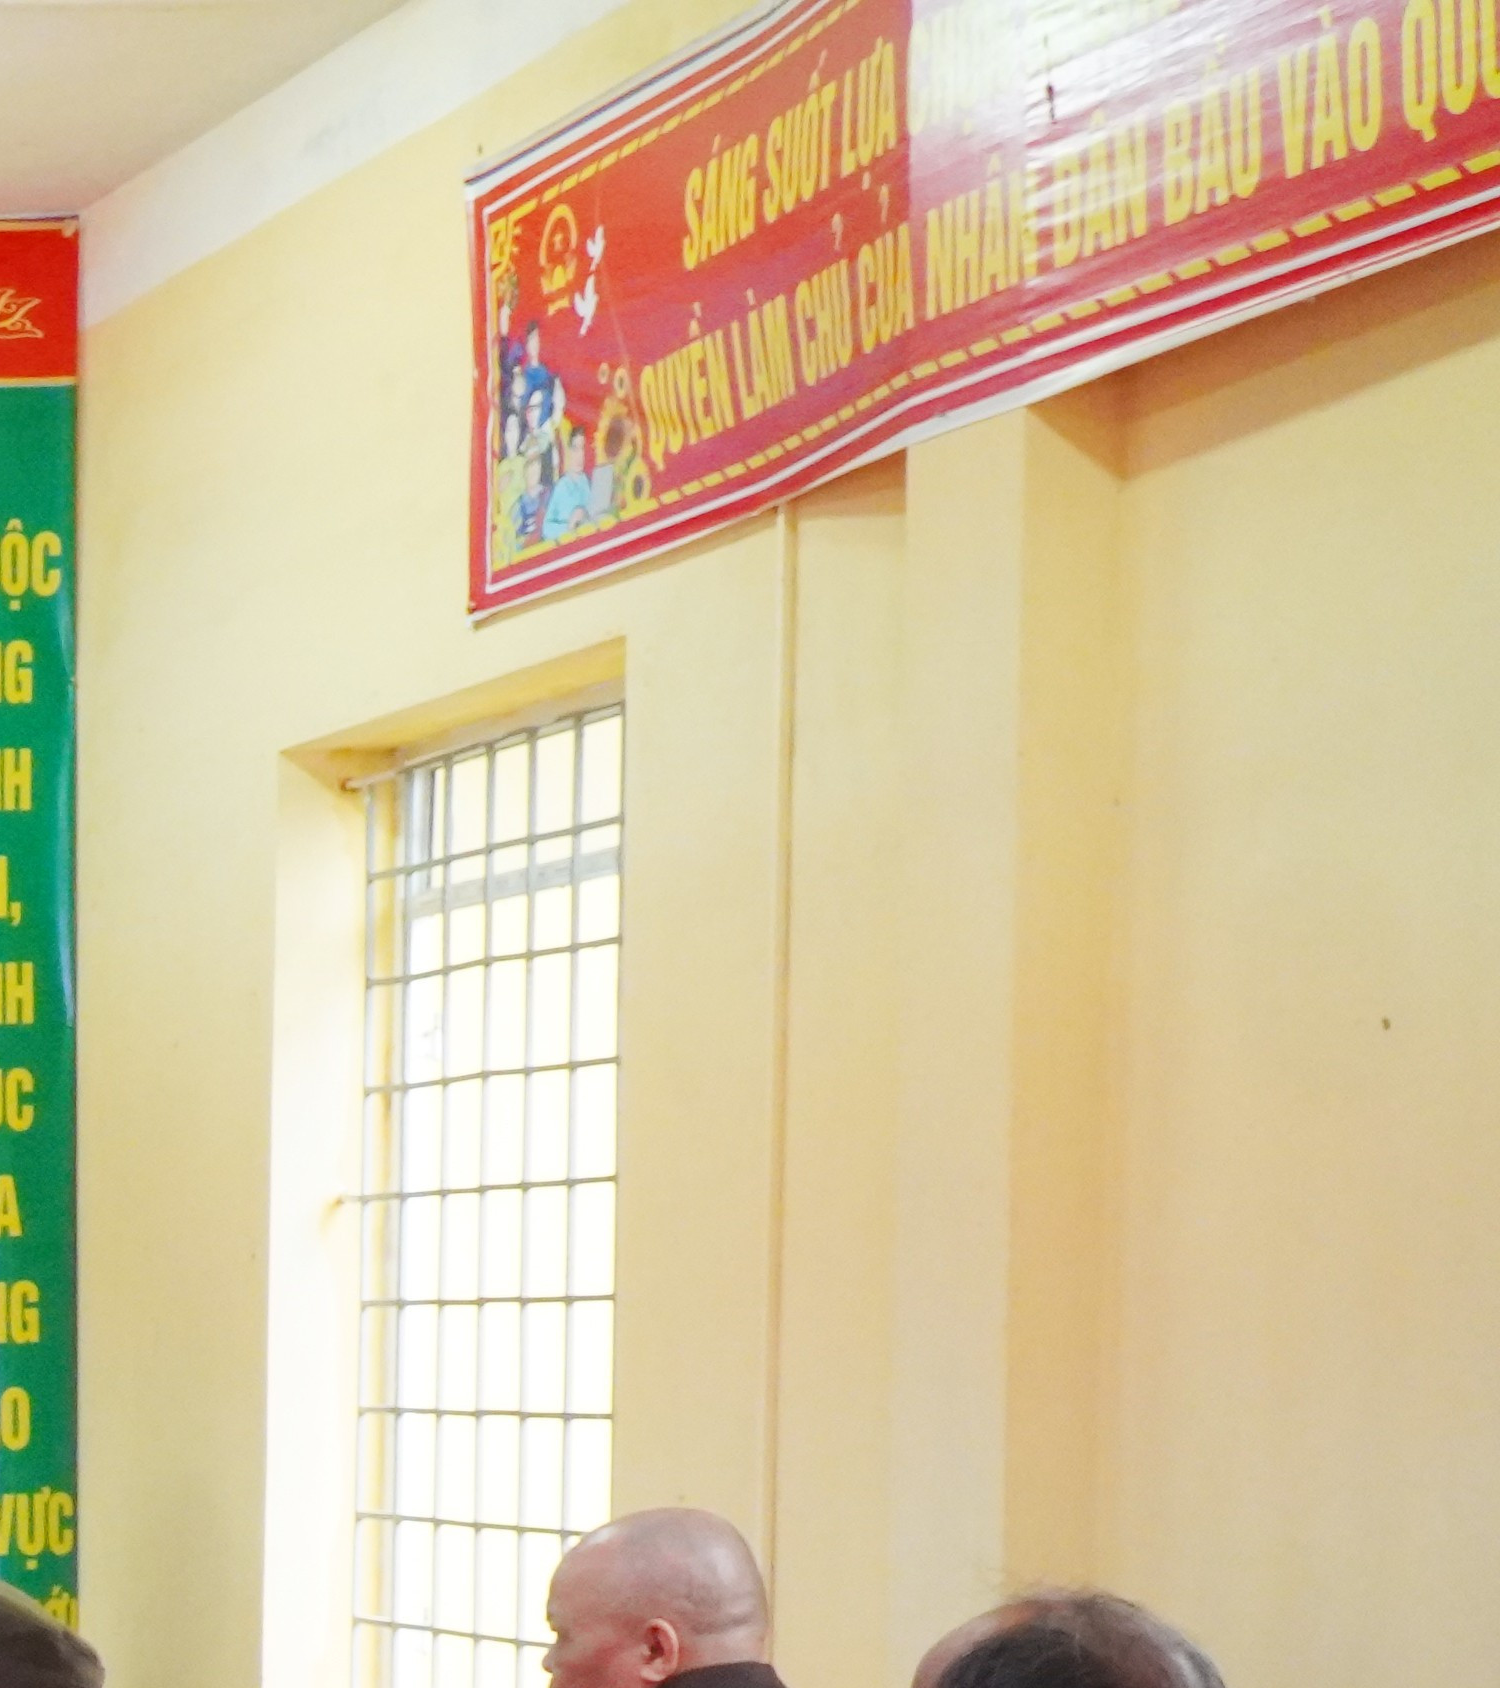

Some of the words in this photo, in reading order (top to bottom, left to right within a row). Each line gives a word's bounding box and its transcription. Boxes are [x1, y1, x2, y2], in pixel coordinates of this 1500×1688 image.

[639, 301, 735, 471] QUYỀN
[730, 288, 797, 421] LÀM
[795, 212, 853, 387] CHỦ
[857, 184, 915, 355] CỦA
[927, 152, 1038, 321] NHÂN
[1053, 110, 1147, 270] DÂN
[1162, 34, 1262, 227] BẦU
[1278, 6, 1384, 180] VÀO
[682, 133, 759, 271] SÁNG
[763, 49, 838, 224] SUỐT
[840, 36, 898, 190] LỰA
